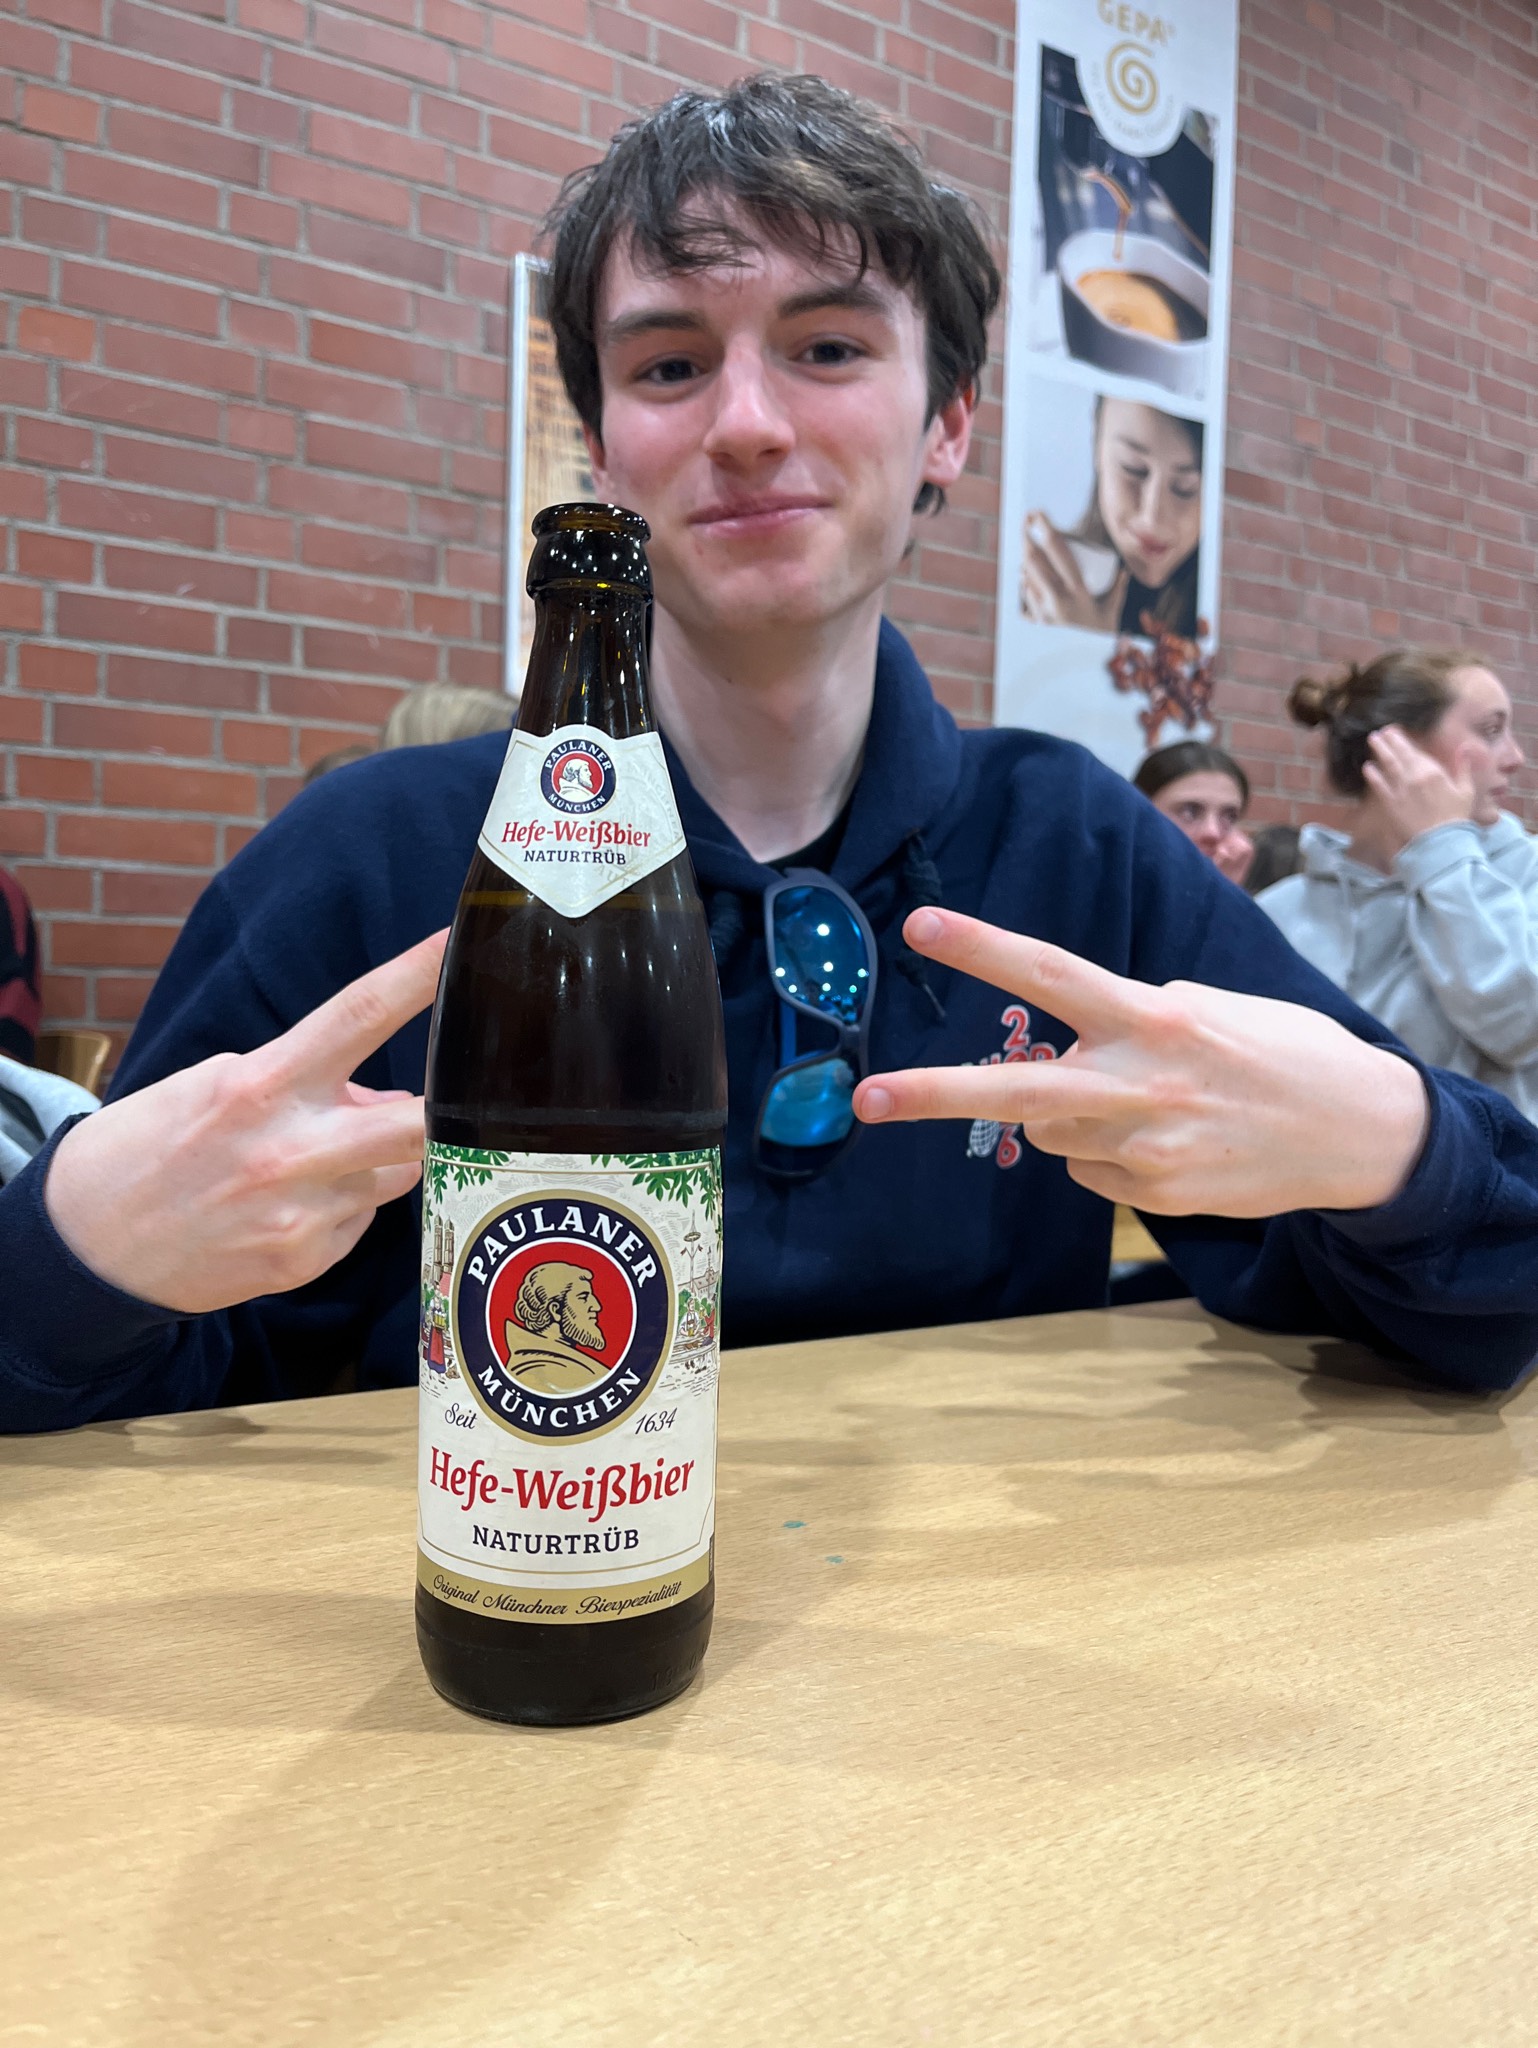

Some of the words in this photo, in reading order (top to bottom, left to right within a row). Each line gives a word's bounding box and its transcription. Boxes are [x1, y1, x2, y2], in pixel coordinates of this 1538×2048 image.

[545, 740, 613, 772] PAULANER
[548, 794, 606, 814] MÜNCHEN
[501, 819, 651, 850] Hefe-Weißbier
[523, 849, 627, 865] NATURTRÜB
[467, 1205, 658, 1289] PAULANER
[478, 1365, 642, 1428] MÜNCHEN
[444, 1402, 478, 1430] Seit
[634, 1407, 678, 1435] 1634
[429, 1445, 696, 1523] Hefe-Weißbier
[472, 1525, 640, 1555] NATURTRÜB
[433, 1574, 479, 1605] Original
[482, 1593, 569, 1616] Münchner
[576, 1580, 683, 1617] Bierspezialität
